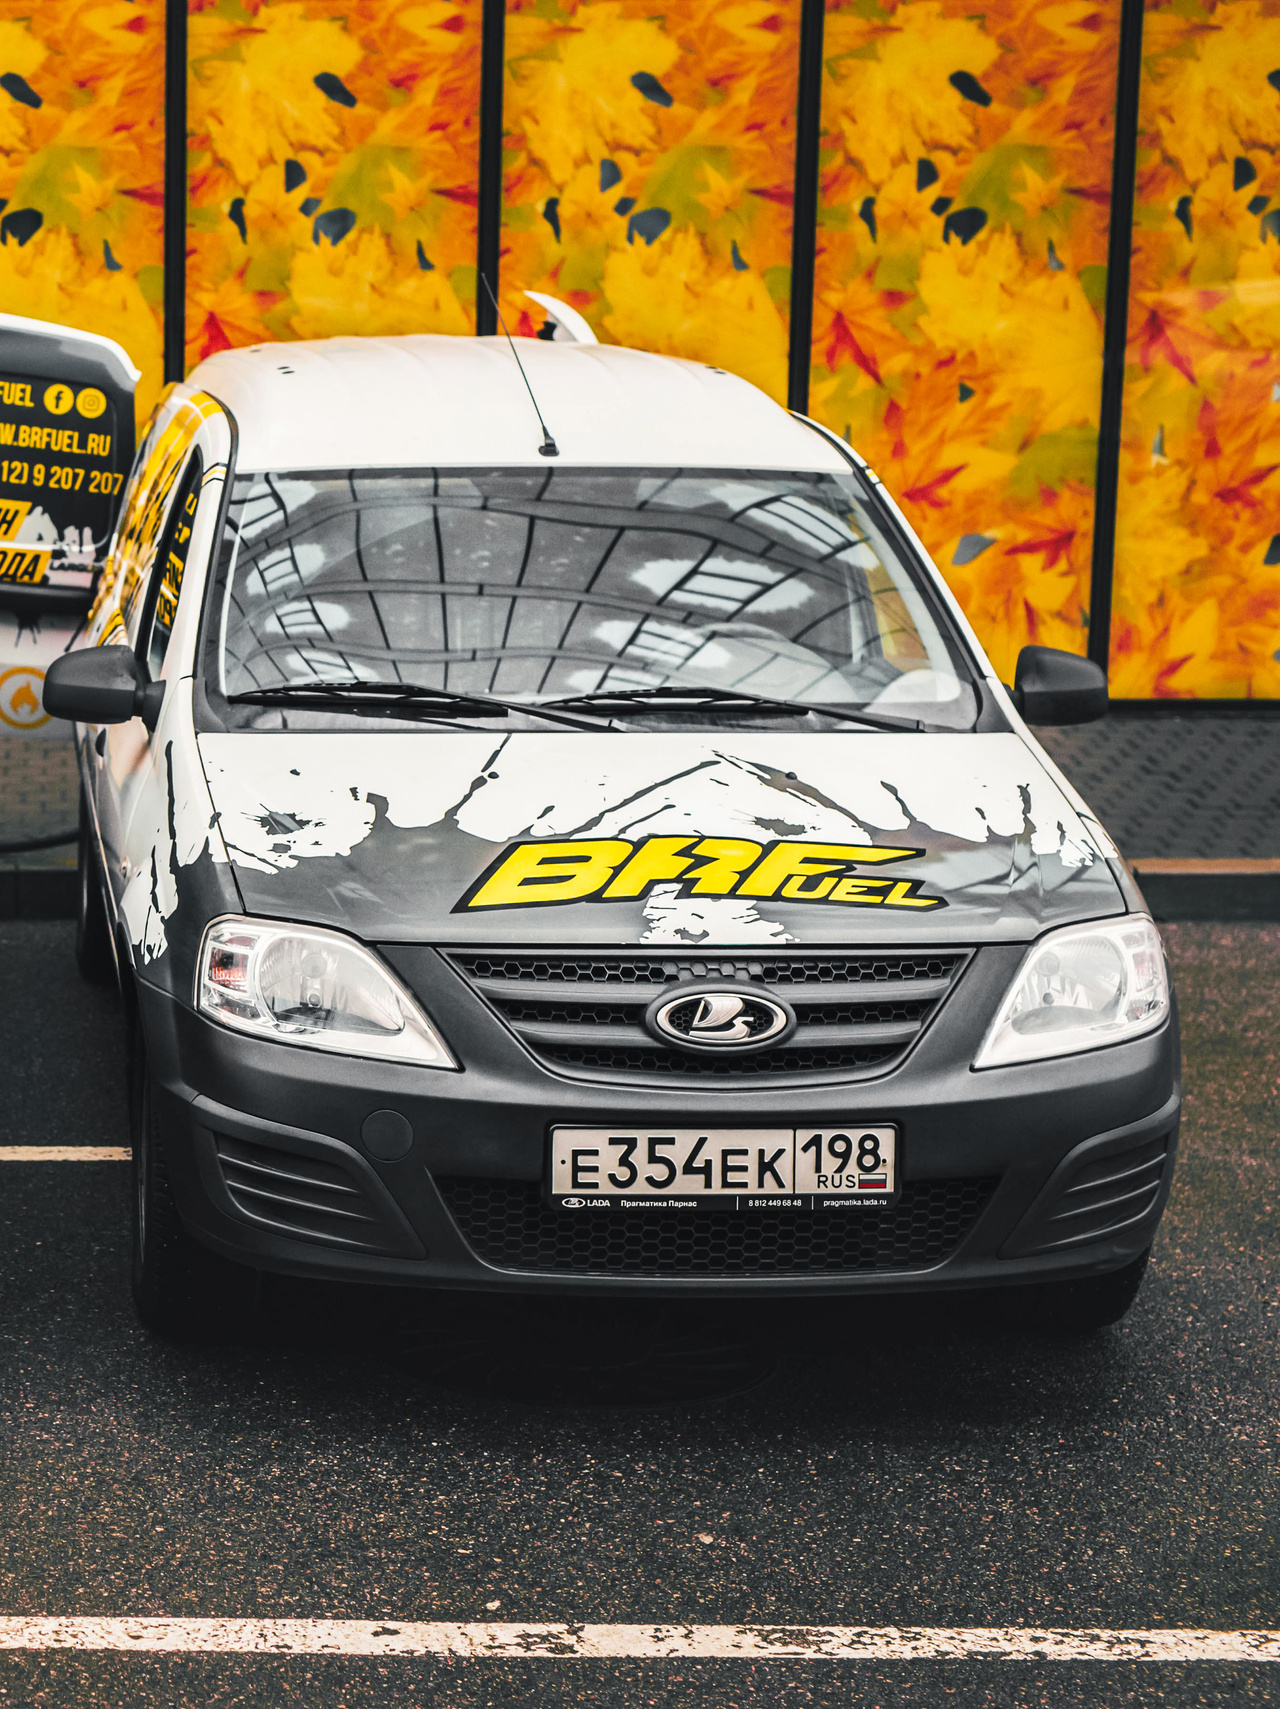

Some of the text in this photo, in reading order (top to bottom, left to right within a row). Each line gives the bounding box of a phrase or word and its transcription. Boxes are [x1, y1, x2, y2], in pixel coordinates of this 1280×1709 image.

[33, 463, 46, 487] 9
[48, 465, 86, 491] 207
[88, 470, 124, 495] 207
[801, 1133, 881, 1174] 198
[817, 1174, 857, 1189] RUS
[587, 1199, 611, 1207] LADA
[621, 1200, 698, 1208] Прагматика Парнас
[754, 1199, 767, 1207] 812
[768, 1199, 782, 1207] 449
[782, 1199, 792, 1207] 68
[792, 1199, 802, 1207] 48
[823, 1199, 887, 1208] pragmatika.lada.ru
